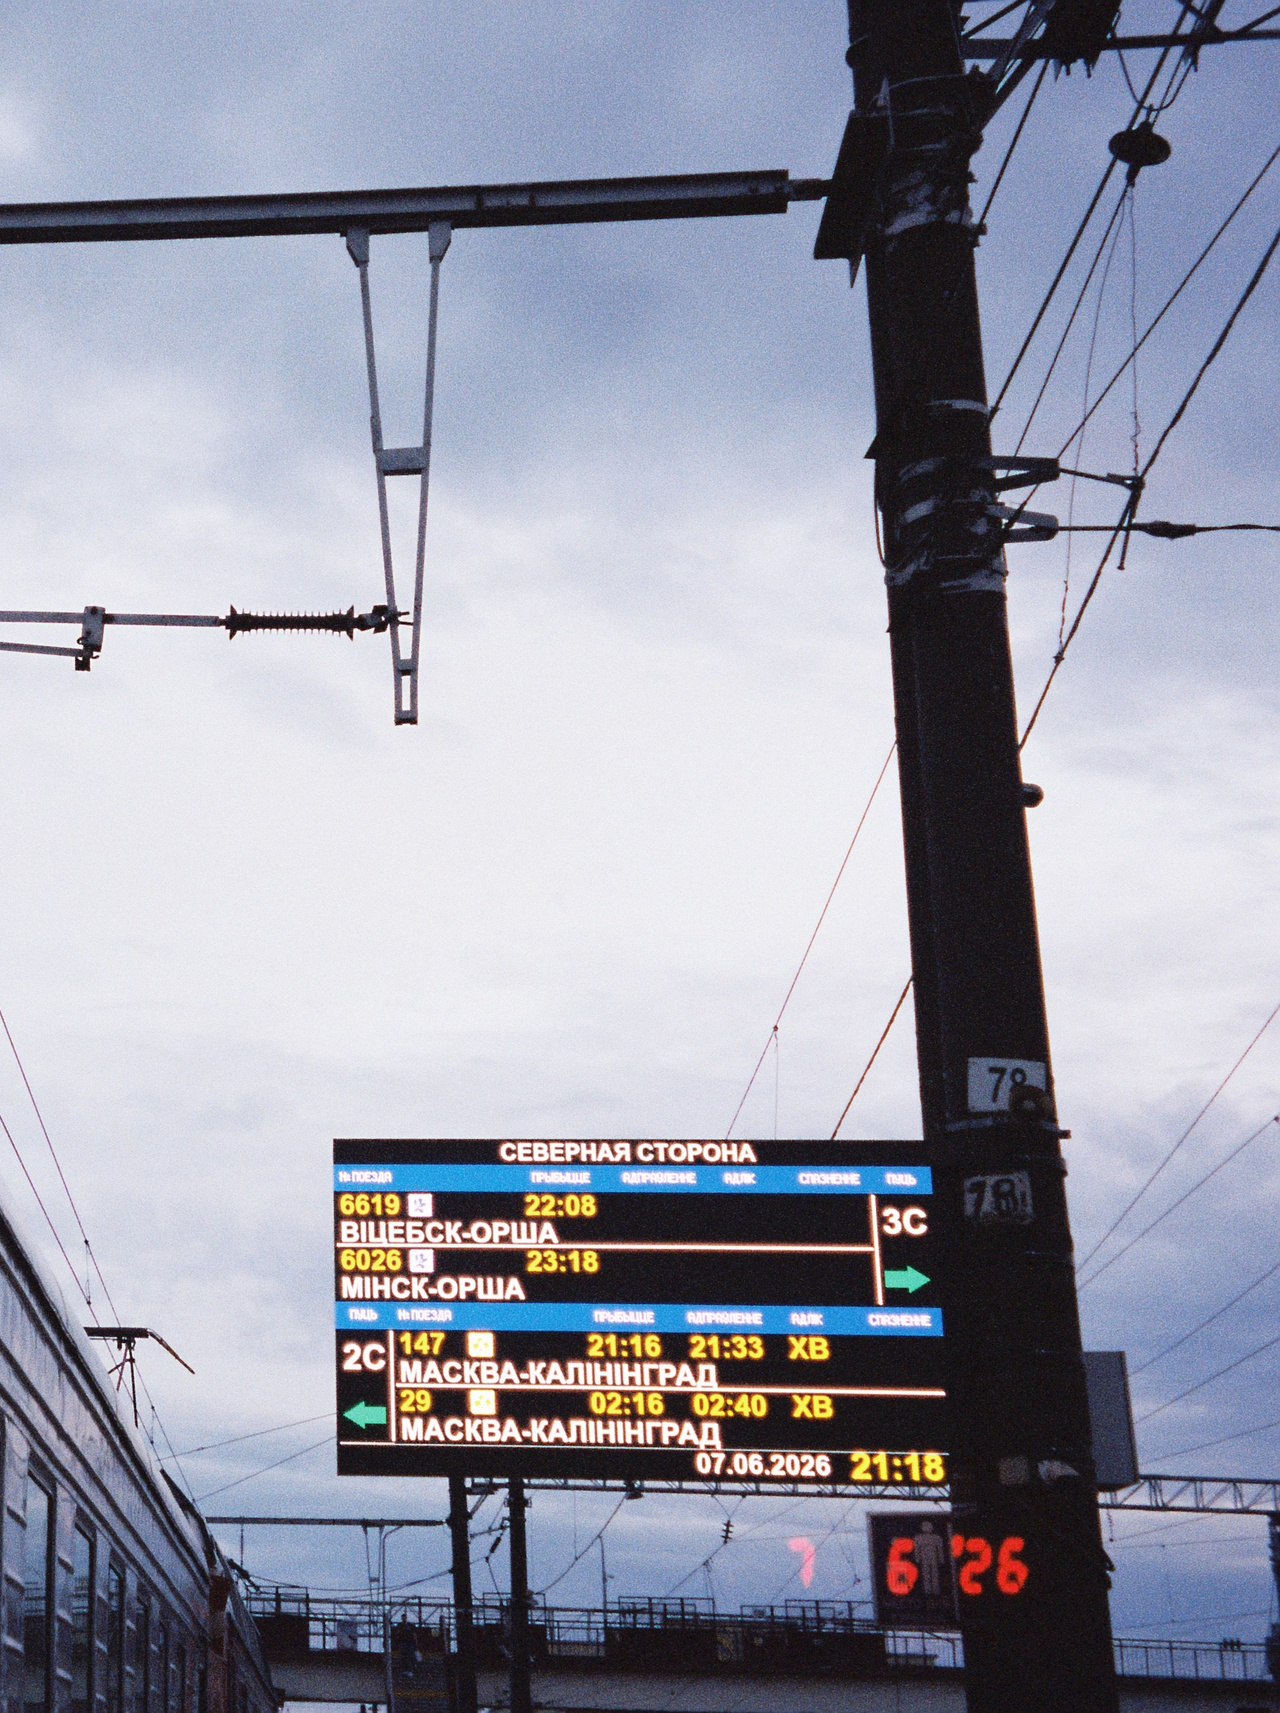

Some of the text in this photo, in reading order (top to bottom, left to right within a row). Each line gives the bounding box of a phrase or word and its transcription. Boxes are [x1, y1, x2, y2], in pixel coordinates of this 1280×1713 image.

[499, 1142, 757, 1162] СЕВЕРНАЯ СТОРОНА
[885, 1173, 917, 1186] ПУЦЬ
[339, 1194, 598, 1217] 6619 22:08
[340, 1221, 559, 1245] ВІЦЕБСК-ОРША
[882, 1207, 928, 1235] 3С
[340, 1249, 599, 1273] 6026 23:18
[342, 1277, 526, 1301] МІНСК-ОРША
[348, 1309, 378, 1321] ПУЦЬ
[342, 1343, 386, 1371] 2С
[400, 1332, 830, 1361] 147 21:16 21:33 ХВ
[400, 1361, 718, 1388] МАСКВА-КАЛІНІНГРАД
[400, 1389, 834, 1419] 29 02:16 02:40 ХВ
[401, 1418, 722, 1449] МАСКВА-КАЛІНІНГРАД
[696, 1452, 945, 1482] 07.06.2026 21:18
